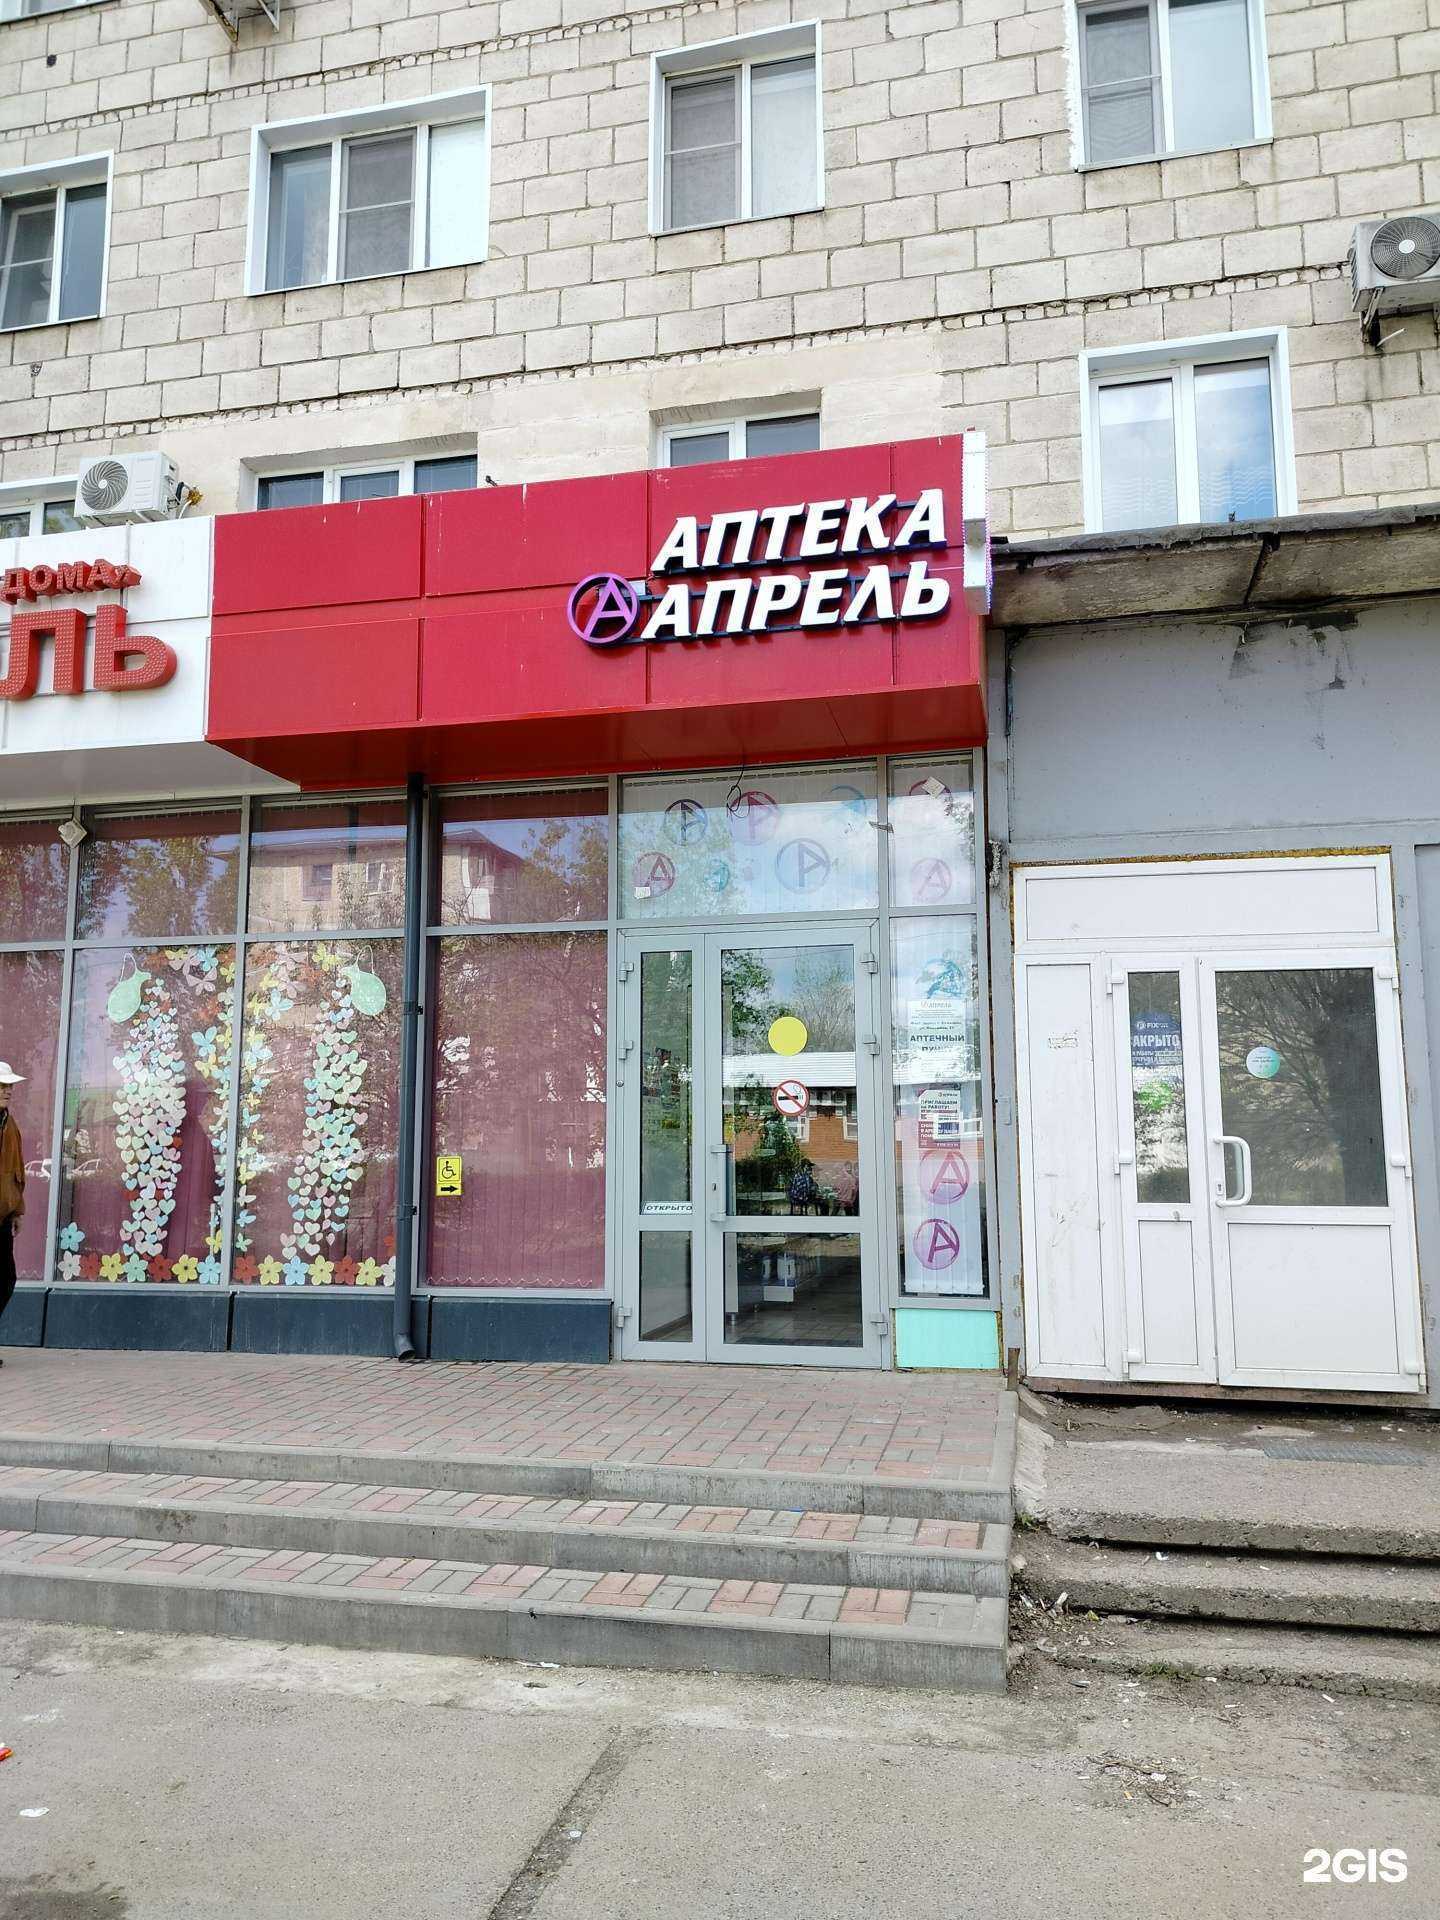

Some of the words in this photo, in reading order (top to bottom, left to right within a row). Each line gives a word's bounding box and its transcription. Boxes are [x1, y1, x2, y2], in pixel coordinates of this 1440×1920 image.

[650, 488, 948, 573] АПТЕКА
[640, 560, 951, 640] АПРЕЛЬ
[910, 1033, 965, 1042] АПТЕЧНЫЙ
[1132, 1034, 1180, 1047] АКРЫТО
